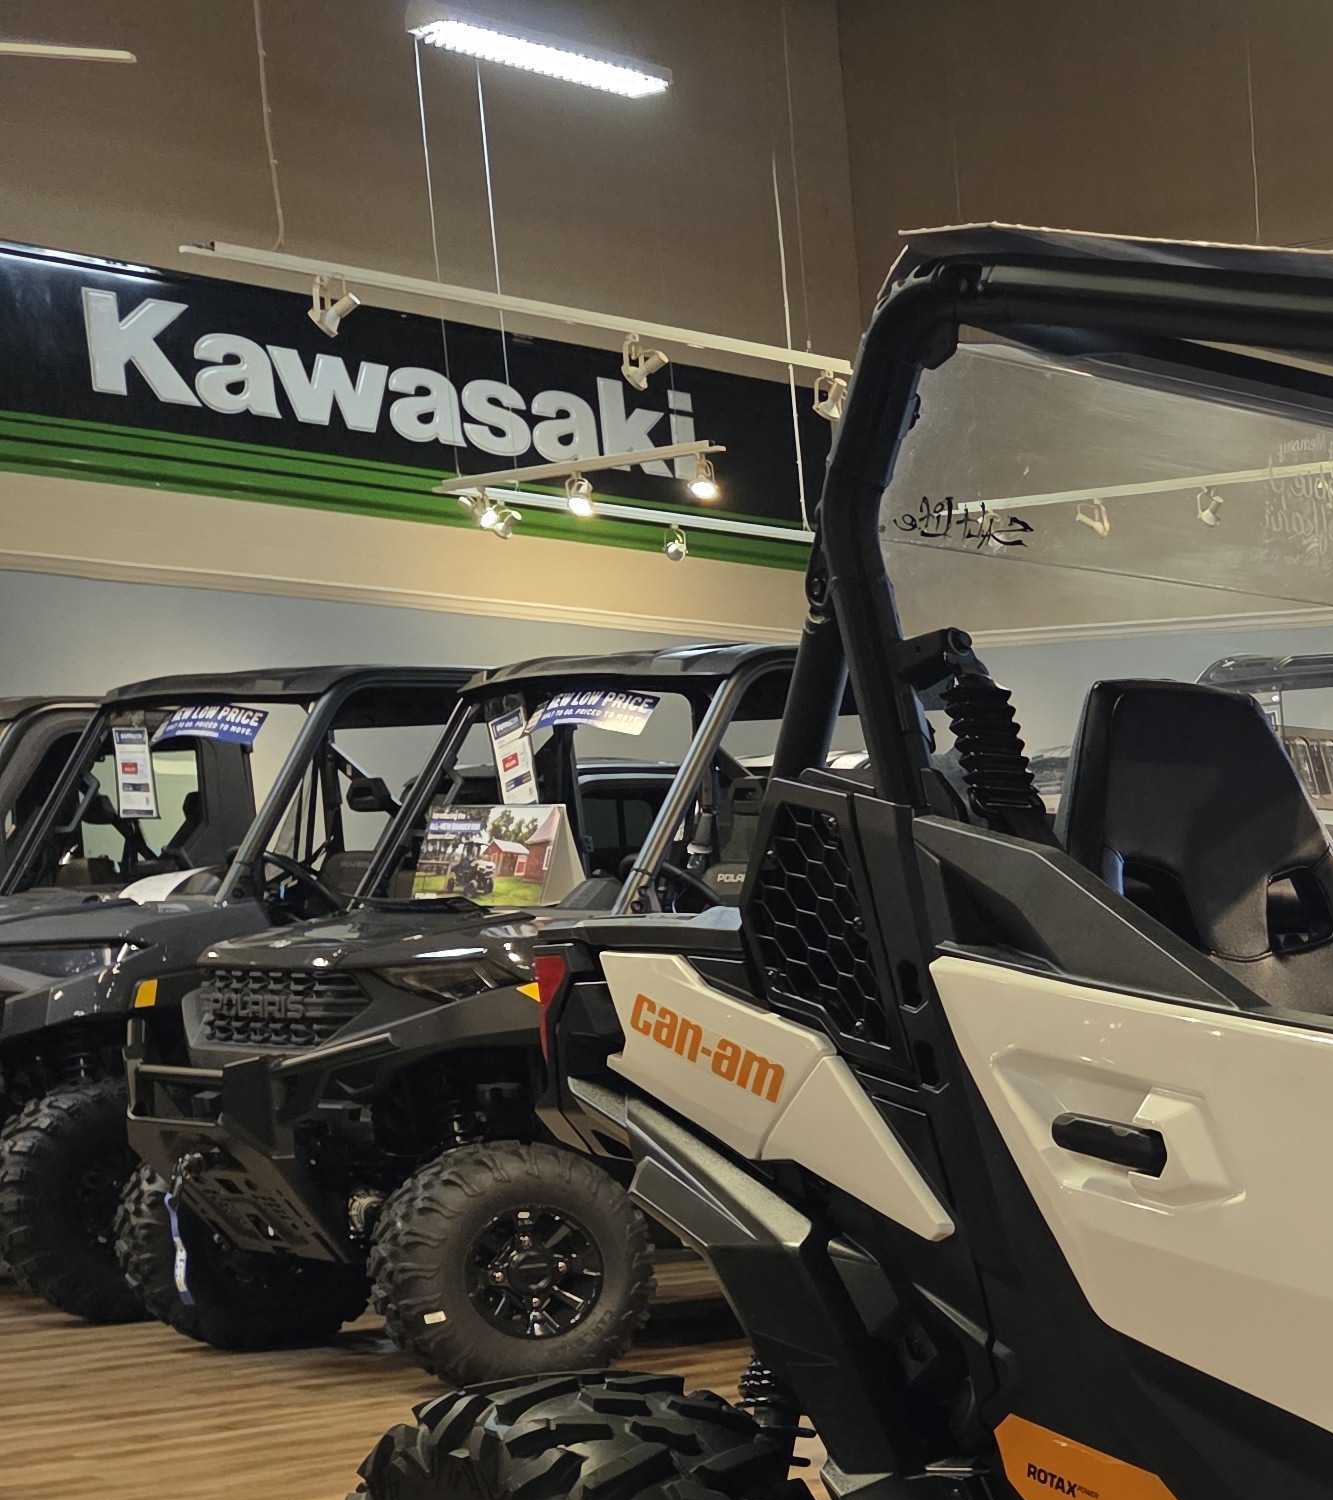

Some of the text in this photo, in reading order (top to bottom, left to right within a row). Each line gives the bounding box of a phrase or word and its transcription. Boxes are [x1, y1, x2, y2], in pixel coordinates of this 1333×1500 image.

[81, 286, 698, 480] Kawasaki
[192, 704, 220, 720] LOW
[218, 706, 264, 727] PRICE
[571, 690, 605, 706] LOW
[601, 691, 654, 713] PRICE
[717, 873, 746, 883] POLA
[630, 992, 785, 1103] can-am
[1027, 1462, 1078, 1498] ROTAX
